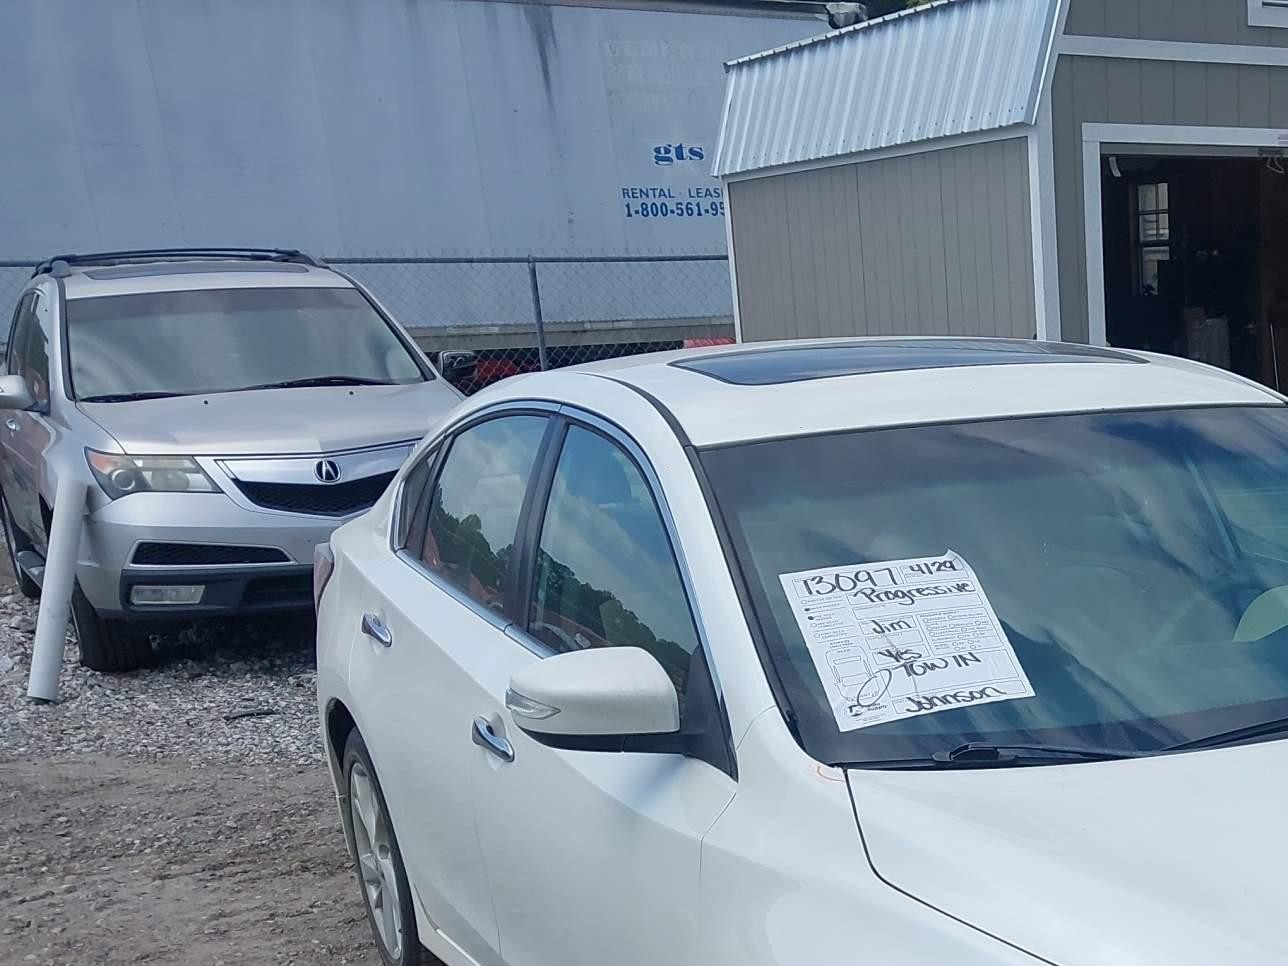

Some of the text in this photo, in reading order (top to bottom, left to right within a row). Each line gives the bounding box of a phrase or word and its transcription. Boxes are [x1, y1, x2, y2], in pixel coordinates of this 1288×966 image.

[654, 143, 705, 166] gts
[622, 187, 724, 199] RENTAL LEAS
[853, 582, 977, 606] Progressive
[870, 619, 912, 634] Jim
[952, 652, 982, 668] IN
[905, 686, 1007, 713] Johnson
